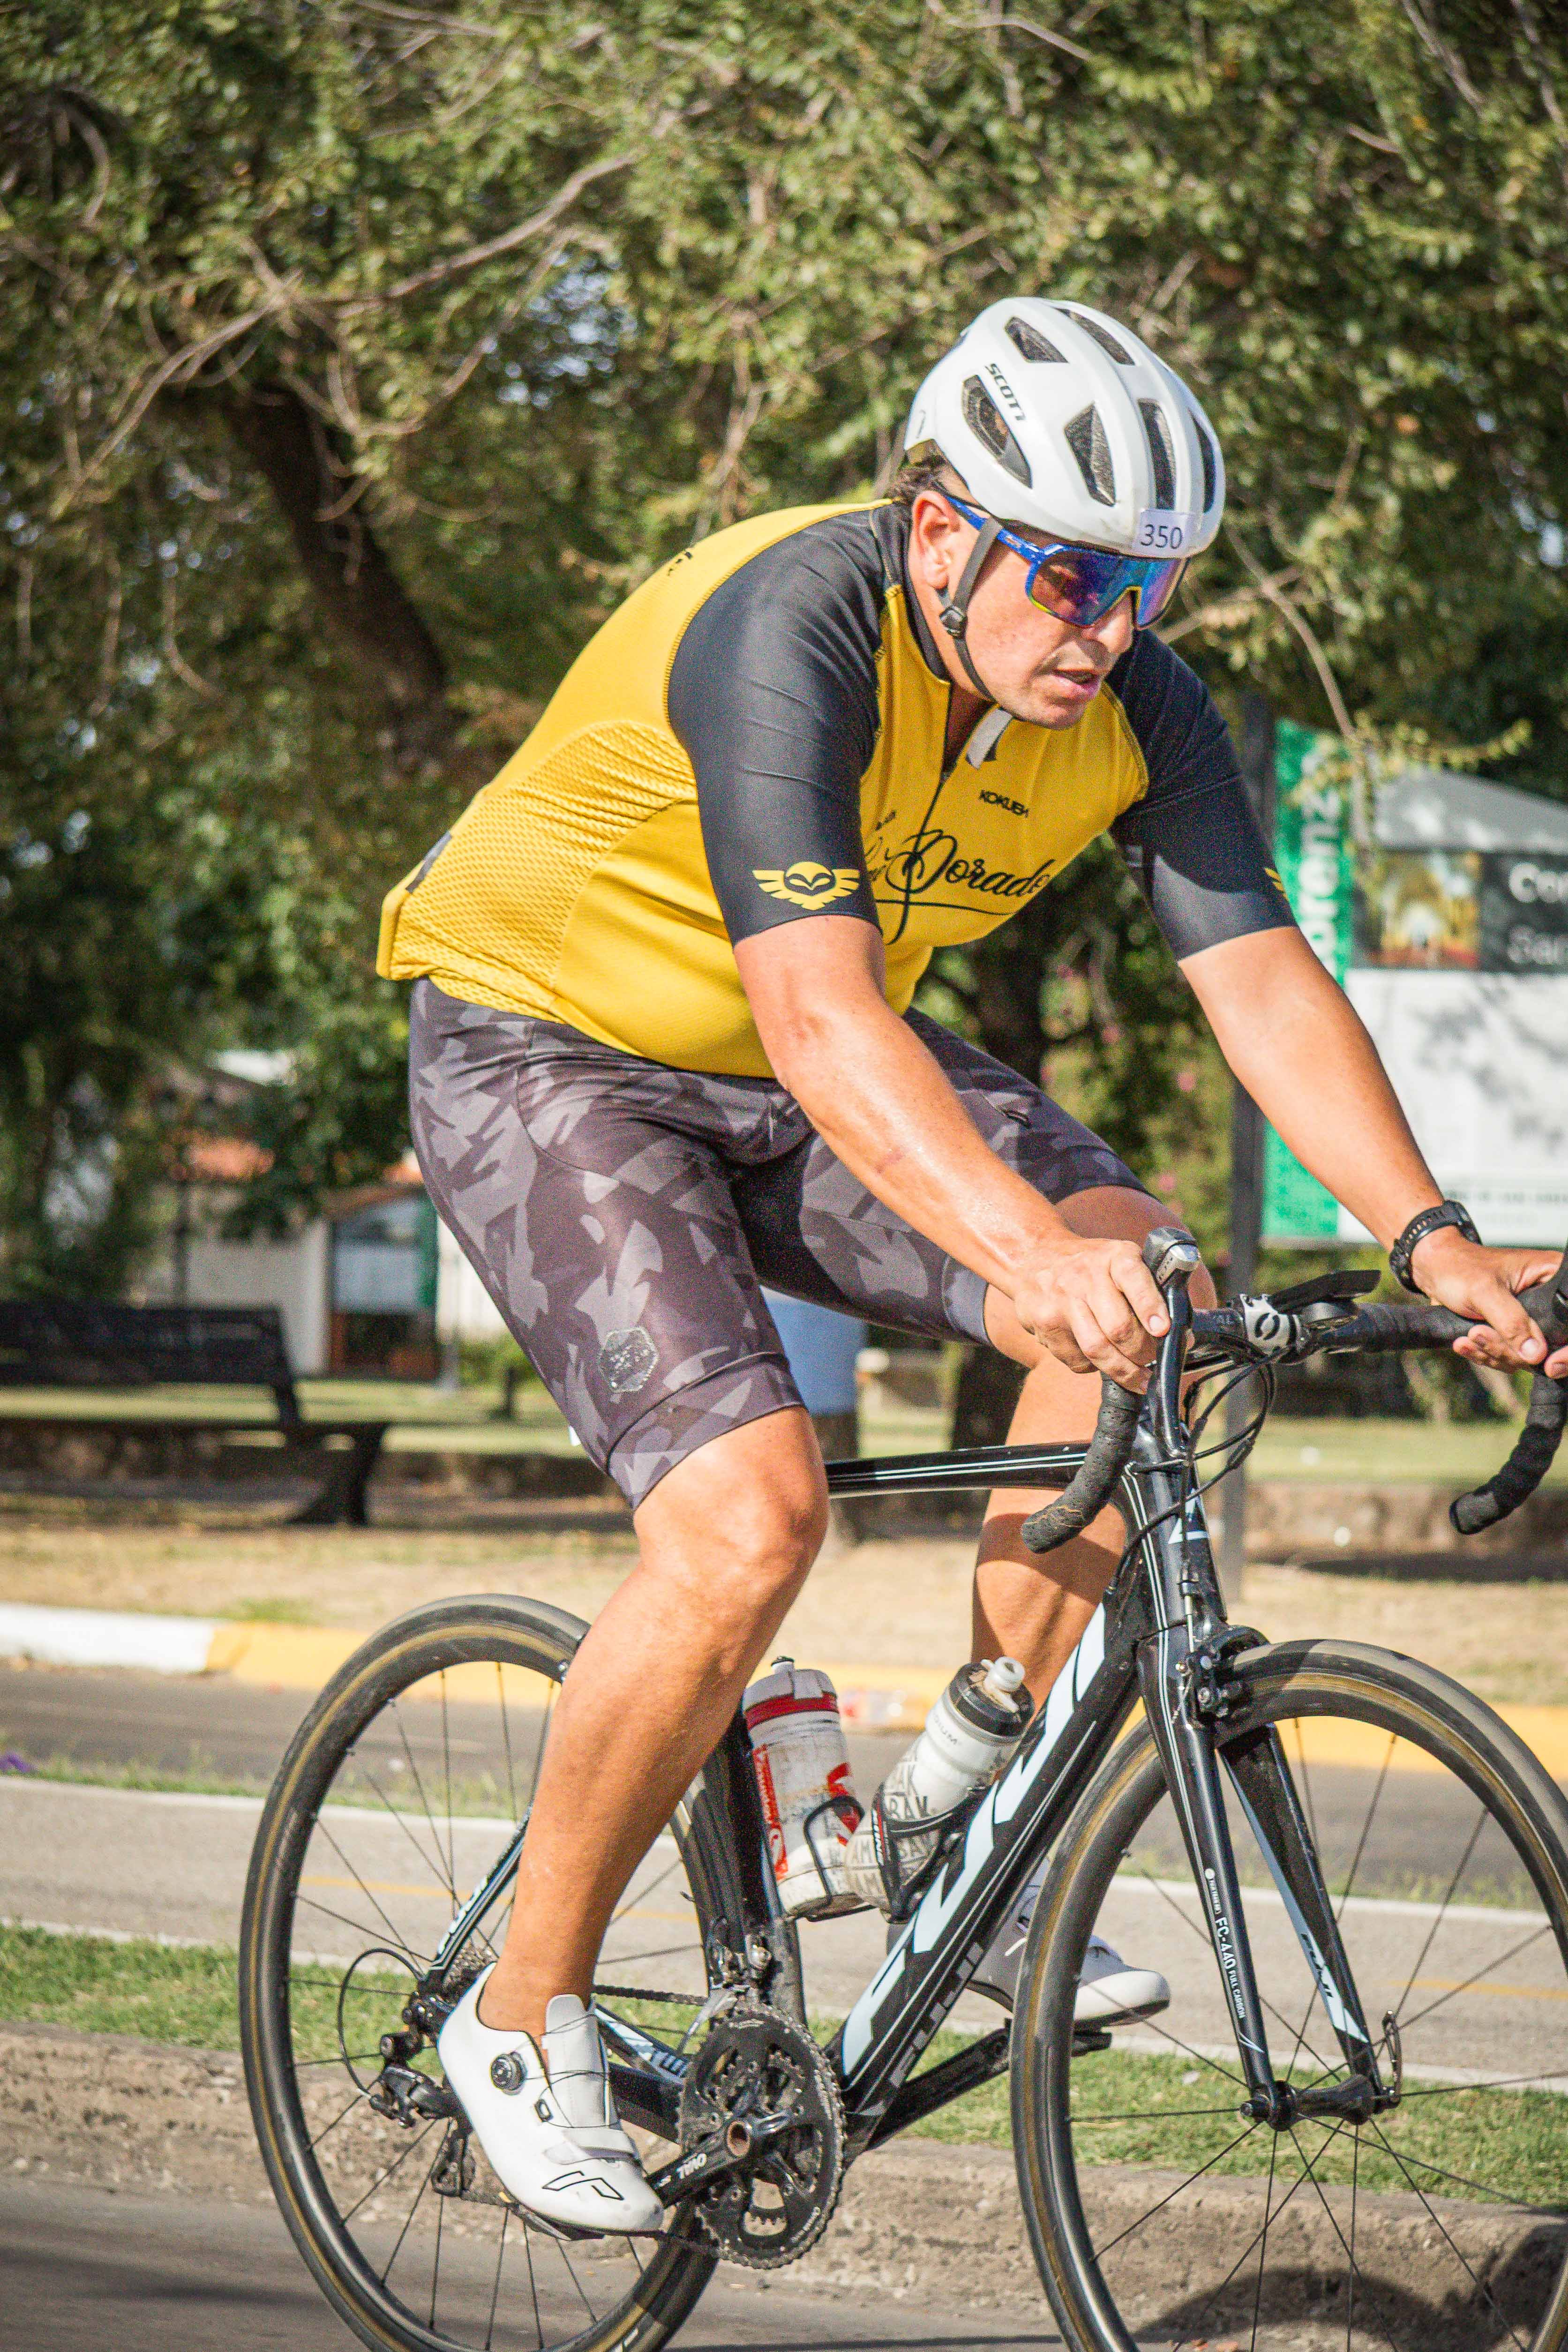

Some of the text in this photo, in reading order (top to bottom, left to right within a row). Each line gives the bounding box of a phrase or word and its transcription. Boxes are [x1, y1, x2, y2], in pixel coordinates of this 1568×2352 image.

[1140, 524, 1183, 549] 350
[1298, 748, 1341, 981] orenz
[843, 1602, 1105, 2076] FUJI
[1215, 1917, 1236, 1970] FC-440
[1228, 1970, 1238, 1990] FULL
